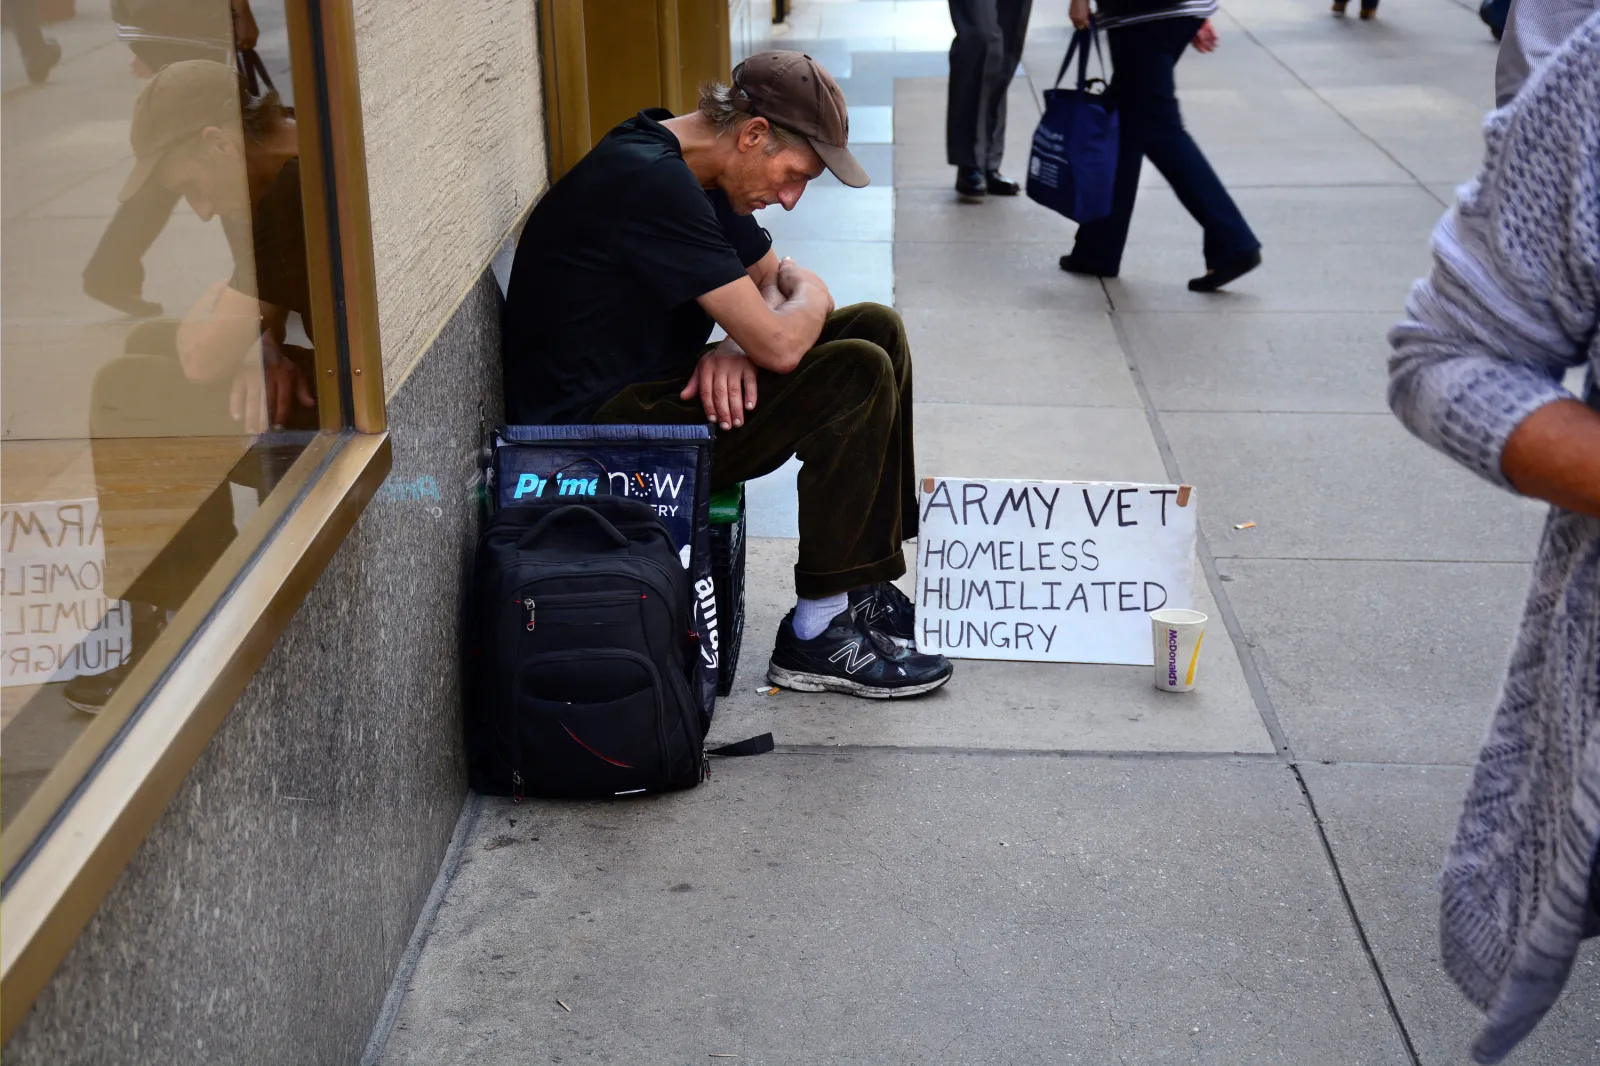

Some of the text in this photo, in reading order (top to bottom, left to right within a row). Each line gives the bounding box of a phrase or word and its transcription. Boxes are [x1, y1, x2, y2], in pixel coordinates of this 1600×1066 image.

[608, 471, 685, 499] now
[922, 480, 1177, 530] ARMY VET
[924, 538, 1099, 572] HOMELESS
[923, 576, 1168, 613] HUMILIATED
[923, 617, 1057, 653] HUNGRY
[1168, 628, 1178, 687] McDonald's
